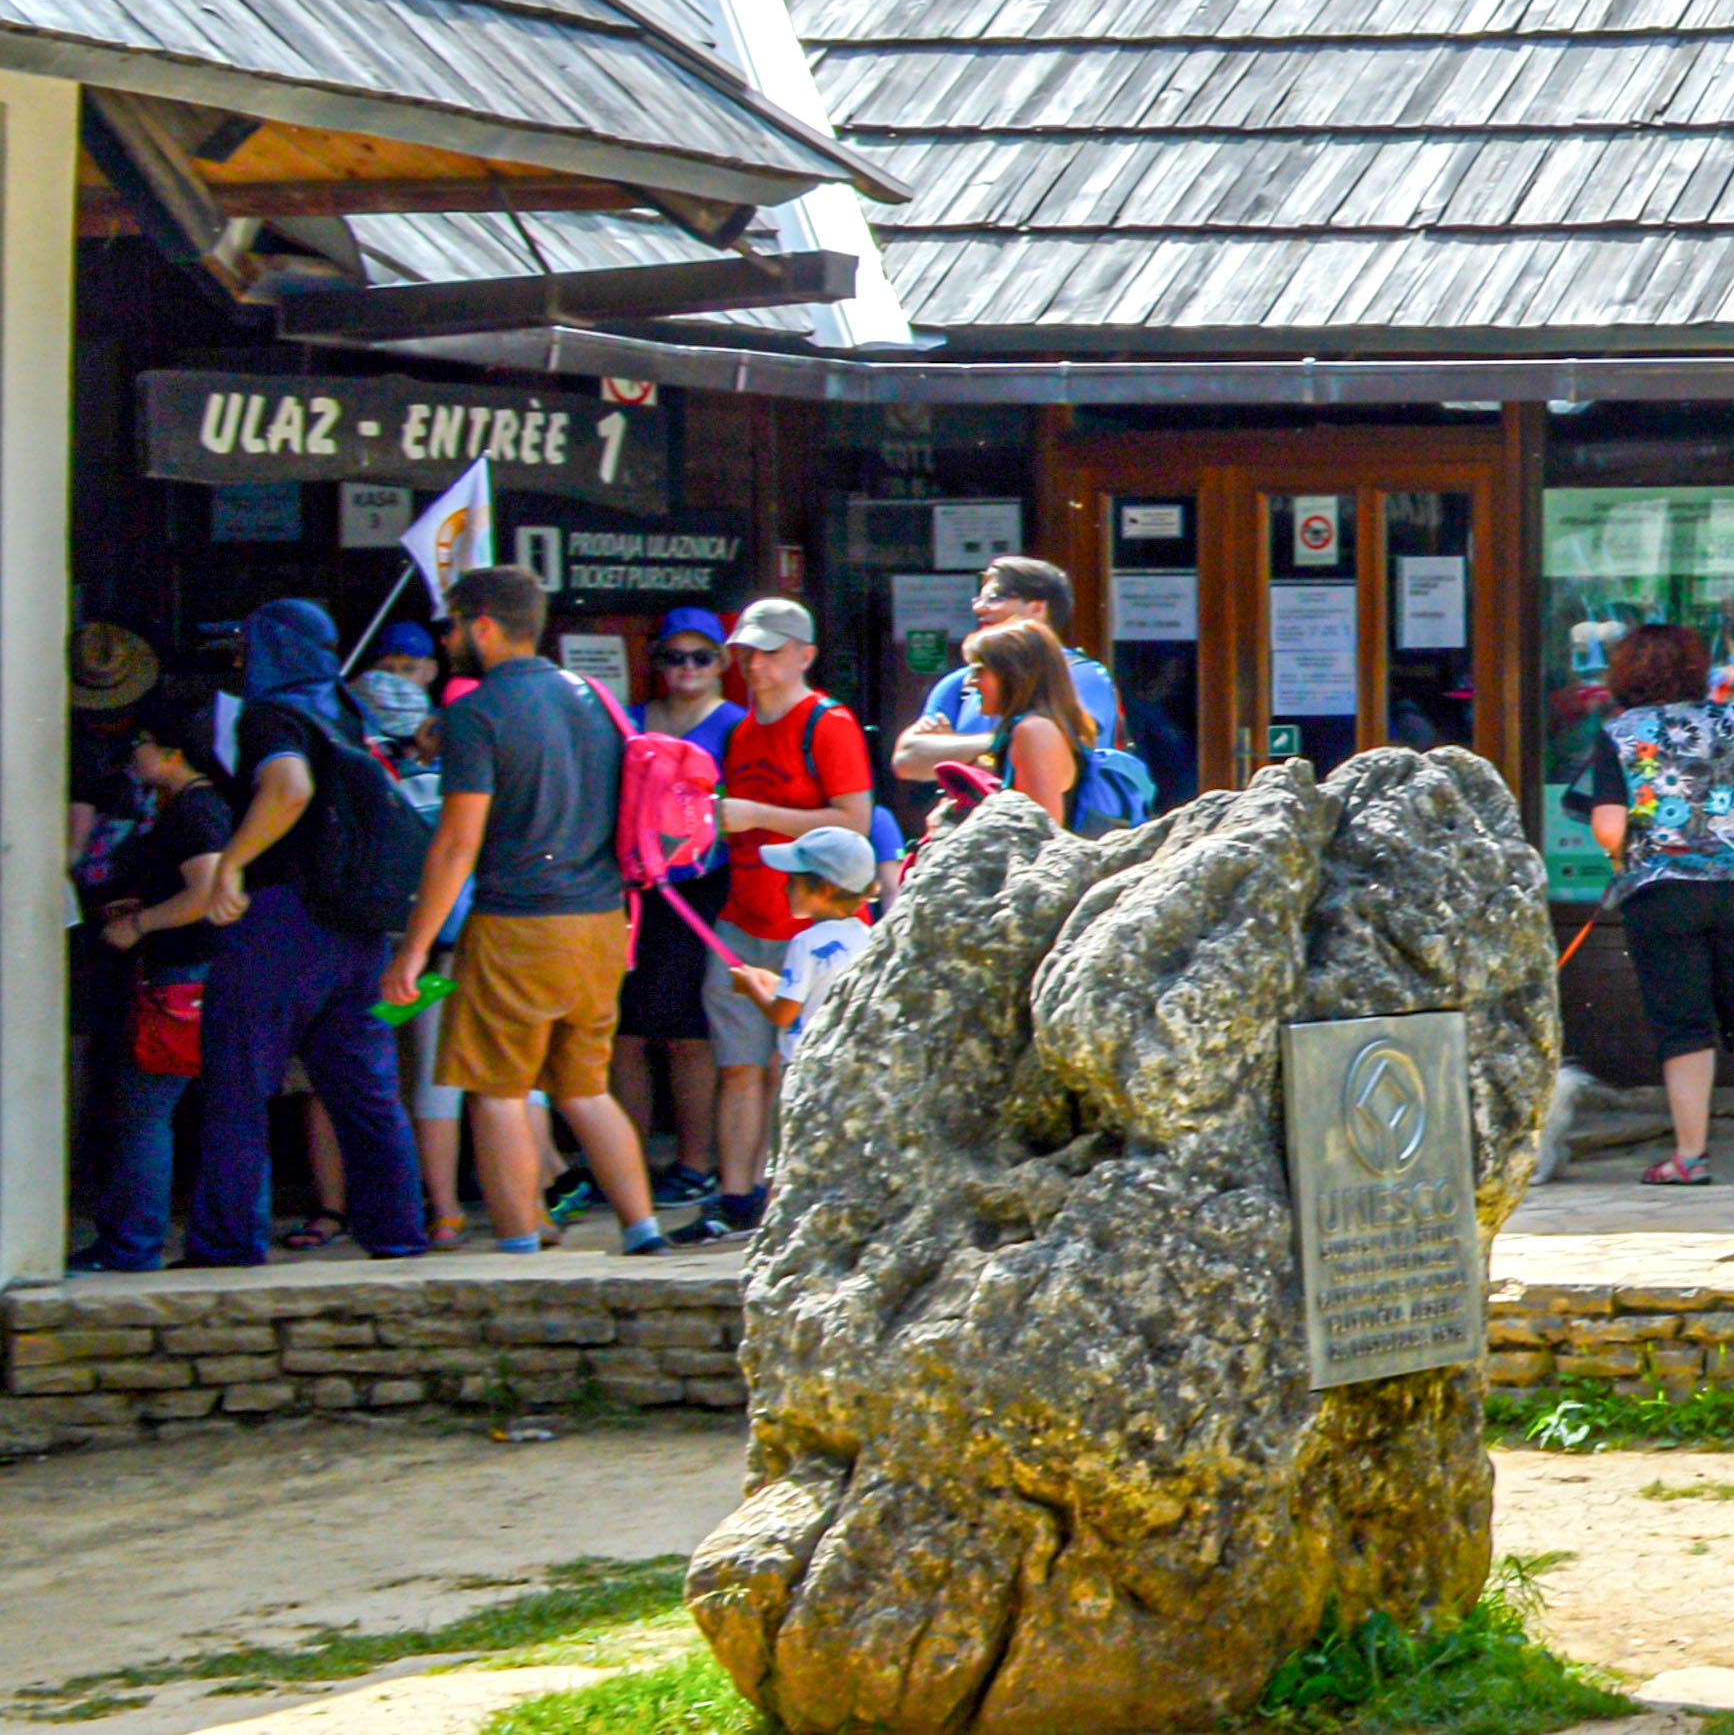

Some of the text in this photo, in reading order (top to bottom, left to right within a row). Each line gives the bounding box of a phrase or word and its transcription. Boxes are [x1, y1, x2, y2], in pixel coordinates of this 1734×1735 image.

[200, 392, 341, 455] ULAZ
[597, 412, 627, 484] 1
[569, 565, 712, 590] TICKET PURCHASE
[1317, 1179, 1458, 1236] UNESCO
